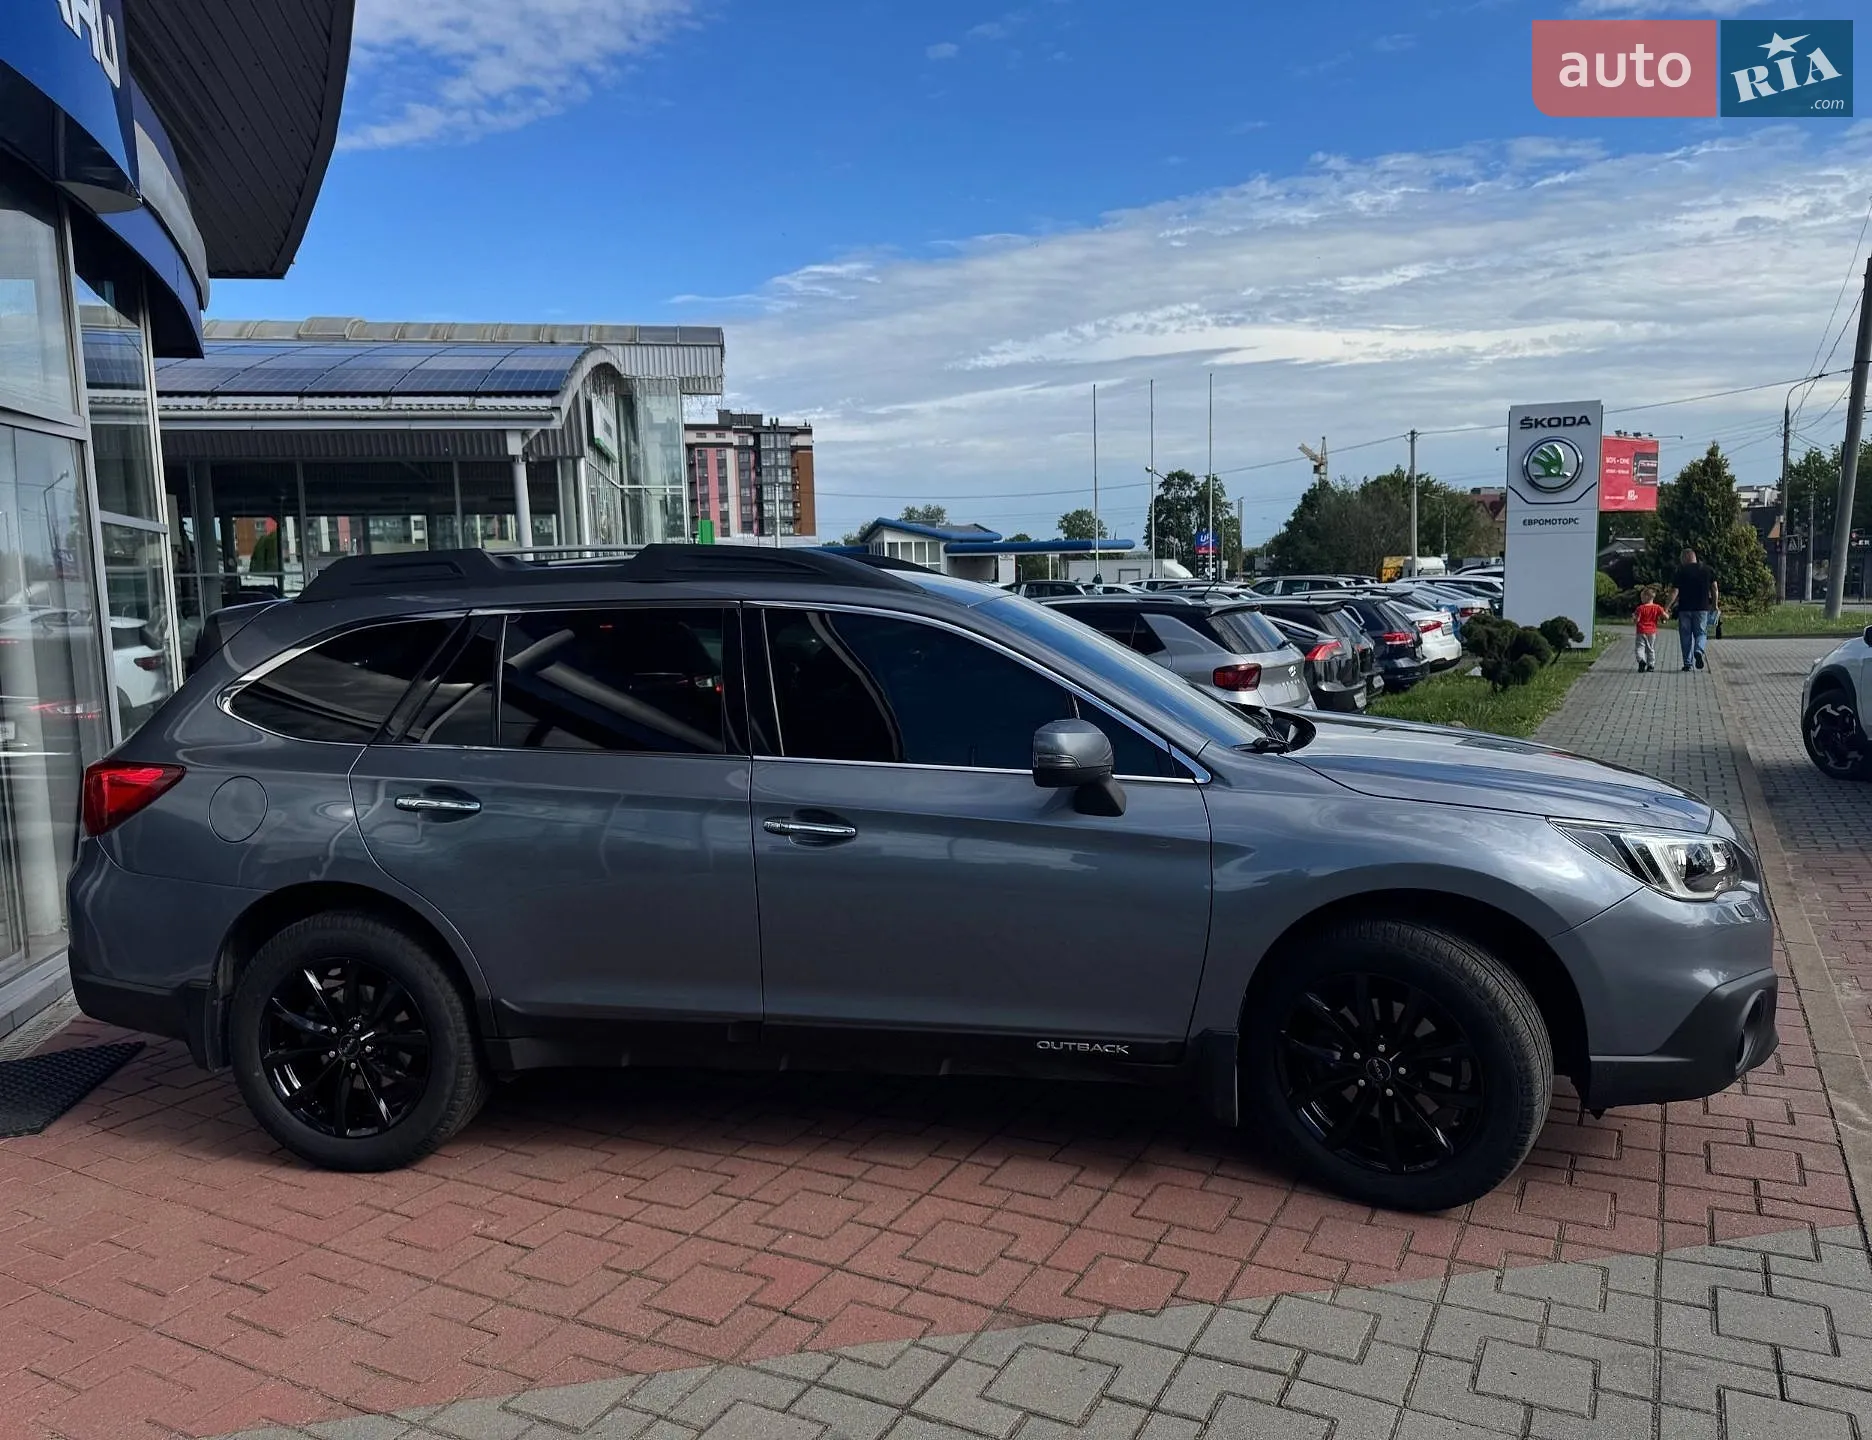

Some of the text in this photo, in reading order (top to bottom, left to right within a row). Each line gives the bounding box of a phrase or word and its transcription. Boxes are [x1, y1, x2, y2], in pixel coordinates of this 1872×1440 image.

[1519, 415, 1592, 430] ŠKODA
[1522, 517, 1580, 527] ЄВРОМОТОРС
[1036, 1040, 1129, 1055] OUTBACK
